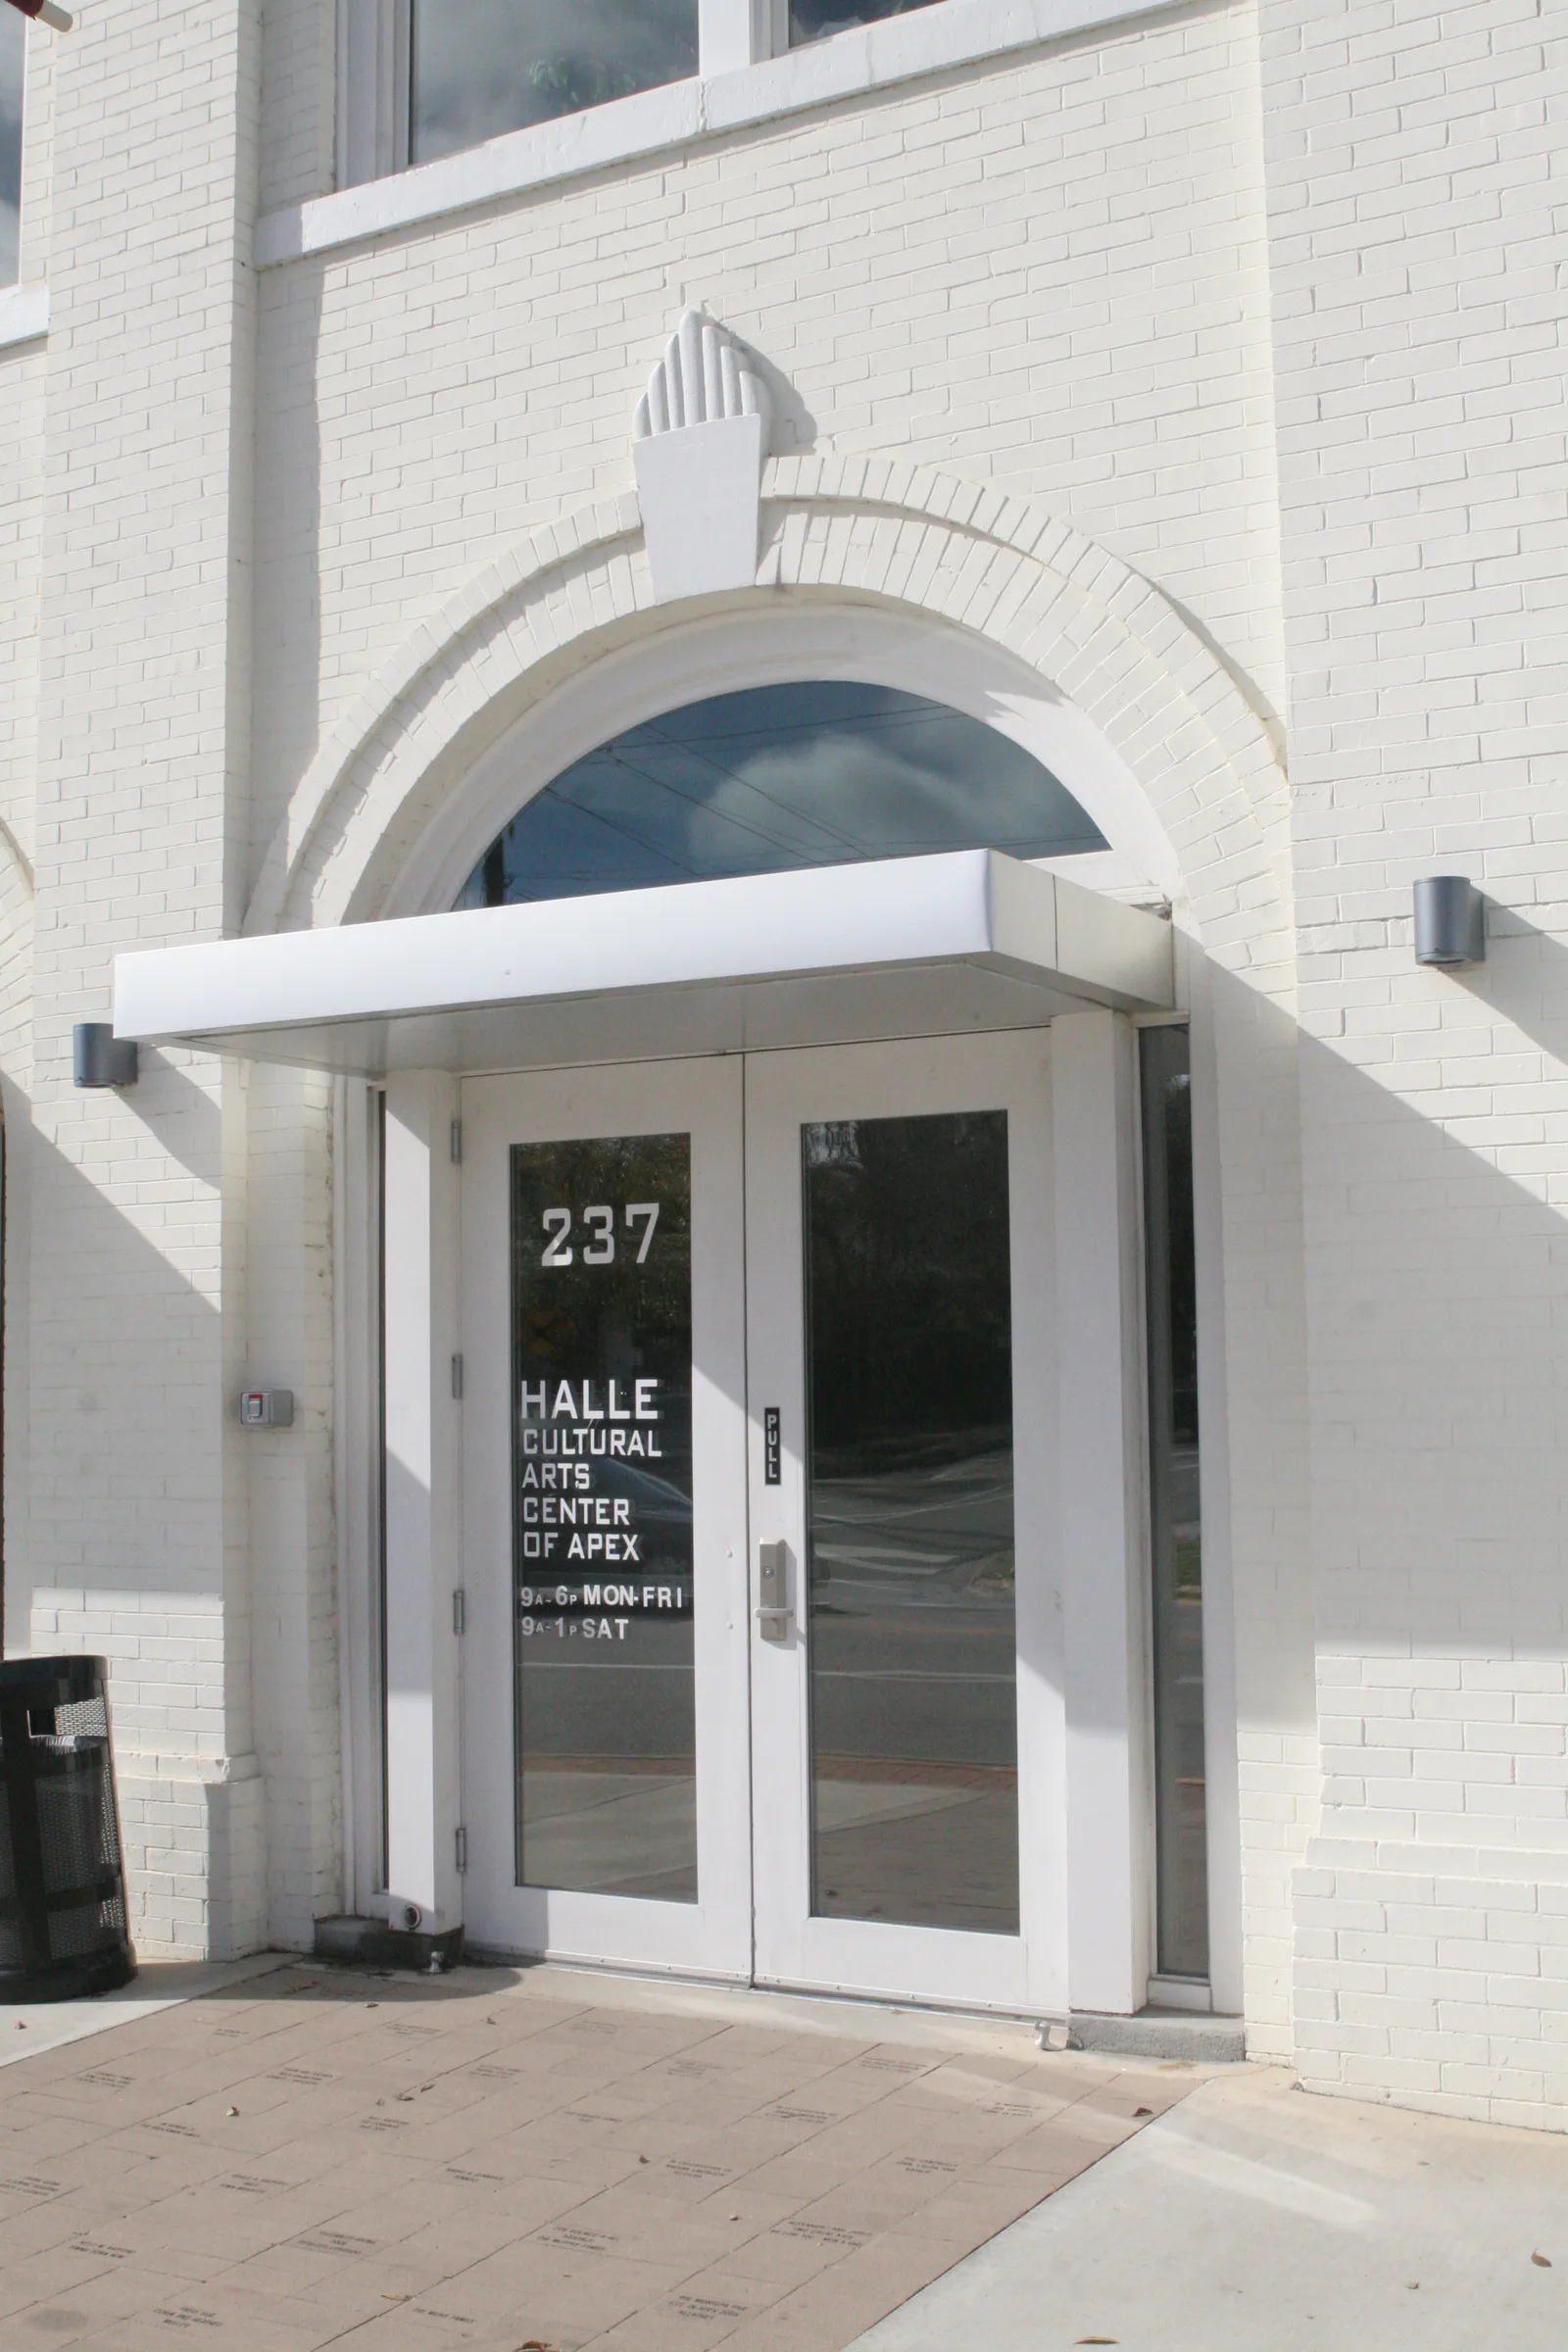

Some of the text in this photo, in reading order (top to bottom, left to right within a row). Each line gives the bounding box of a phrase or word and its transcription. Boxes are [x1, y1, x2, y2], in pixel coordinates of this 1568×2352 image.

[542, 1202, 660, 1267] 237
[521, 1379, 658, 1419] HALLE
[523, 1429, 662, 1456] CULTURAL
[767, 1414, 777, 1478] PULL
[522, 1463, 590, 1489] ARTS
[523, 1497, 630, 1525] CENTER
[524, 1532, 640, 1561] OF APEX
[582, 1618, 629, 1640] SAT
